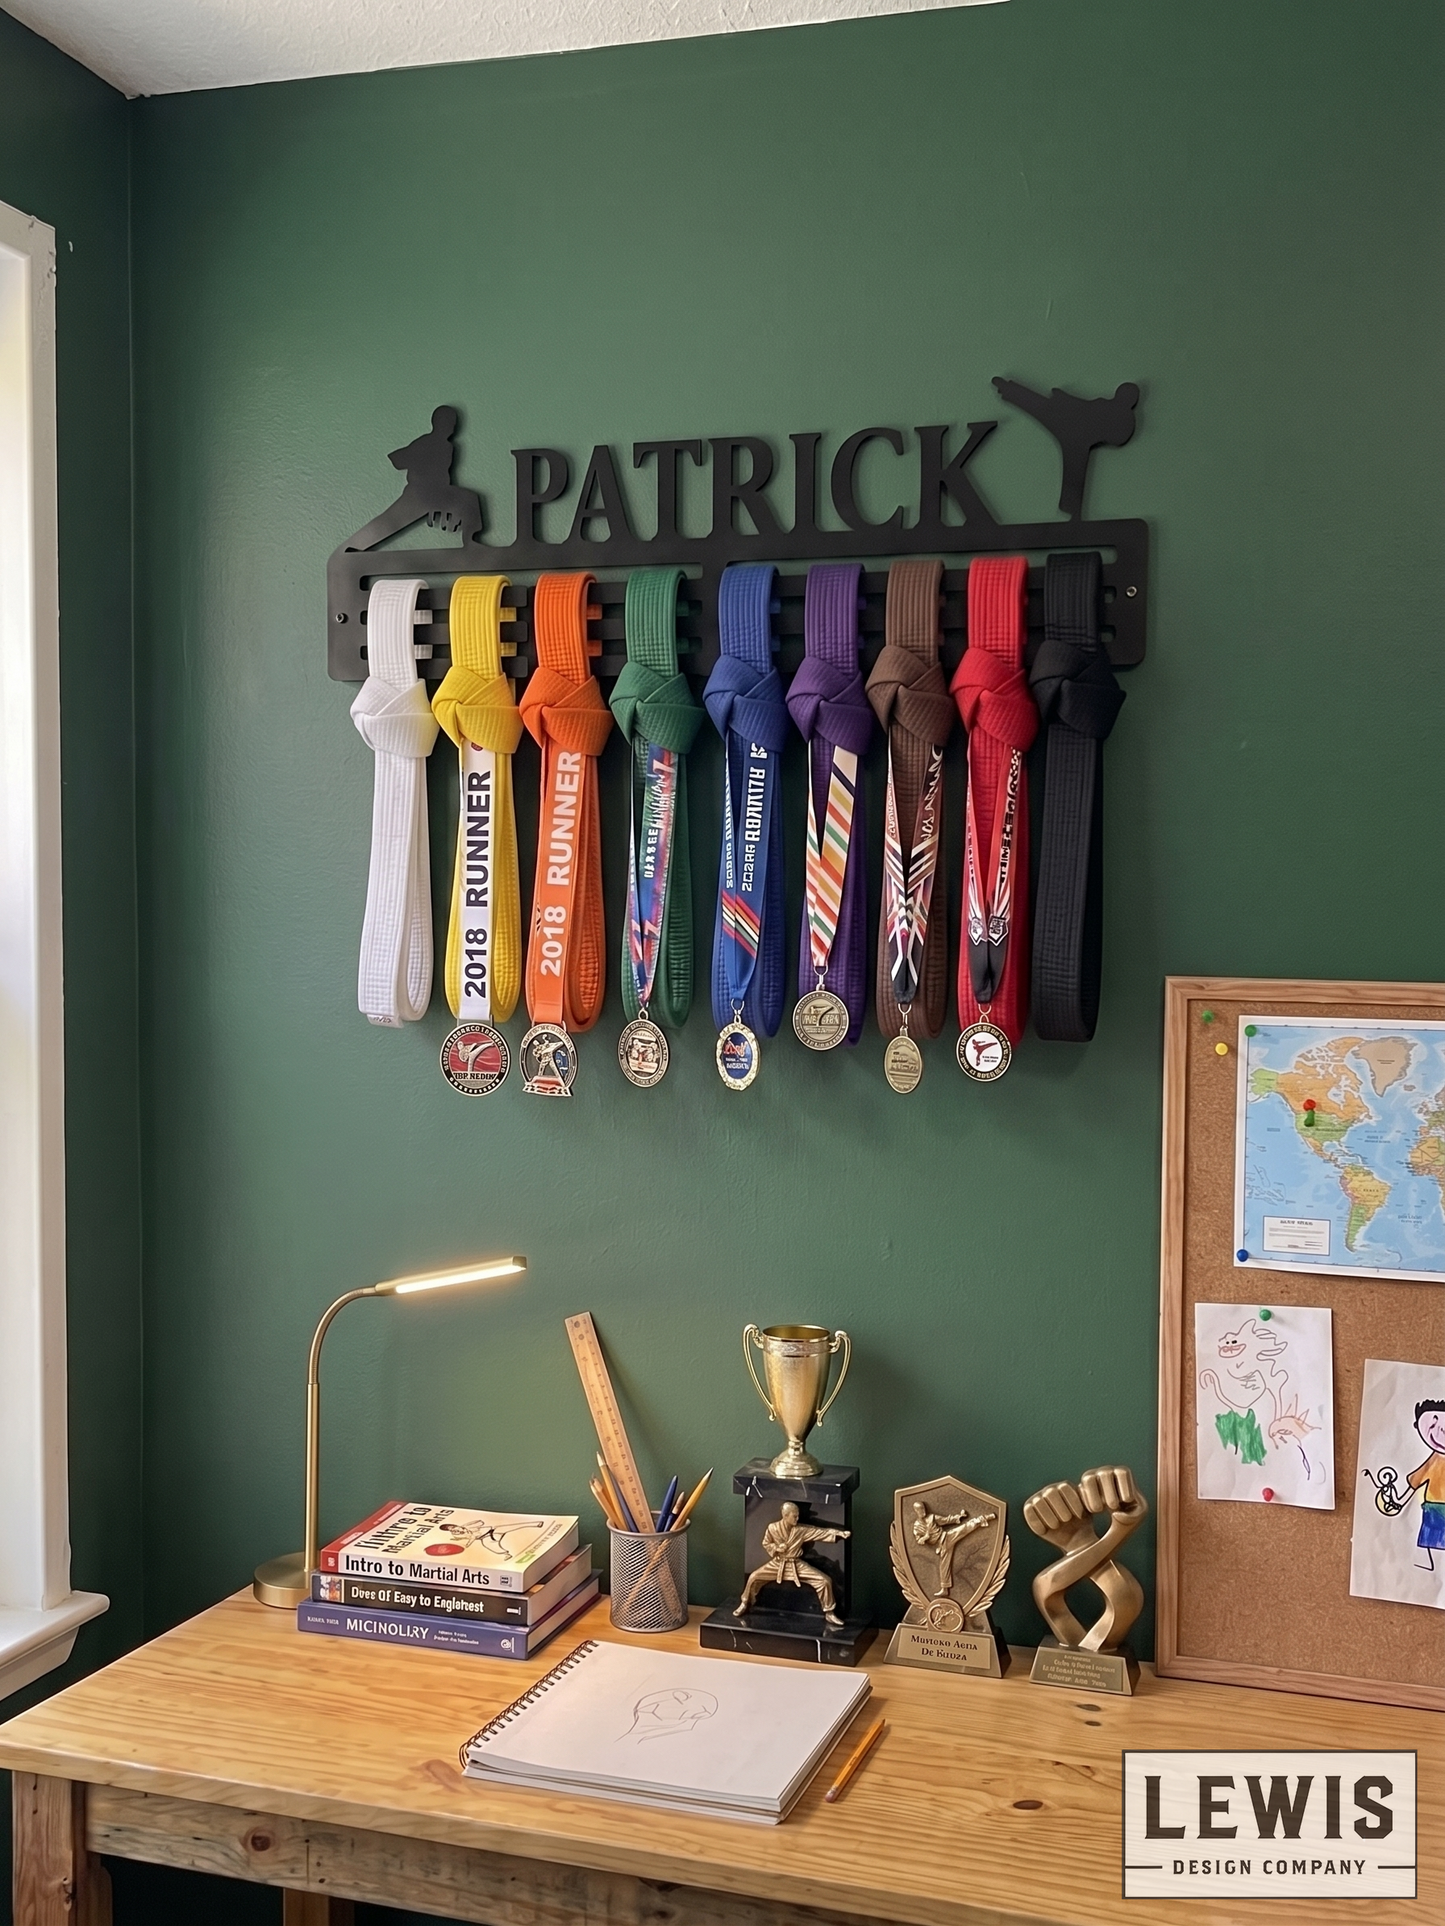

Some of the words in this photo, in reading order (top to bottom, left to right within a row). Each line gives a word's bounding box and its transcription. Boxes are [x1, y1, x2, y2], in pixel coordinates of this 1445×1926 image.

[511, 421, 1000, 545] PATRICK
[466, 770, 491, 908] RUNNER
[547, 750, 582, 886] RUNNER
[464, 928, 488, 999] 2018
[540, 906, 567, 977] 2018
[345, 1554, 383, 1574] Intro
[388, 1560, 404, 1576] to
[409, 1563, 458, 1582] Martial
[462, 1568, 490, 1586] Arts
[394, 1591, 417, 1608] Easy
[419, 1594, 432, 1607] to
